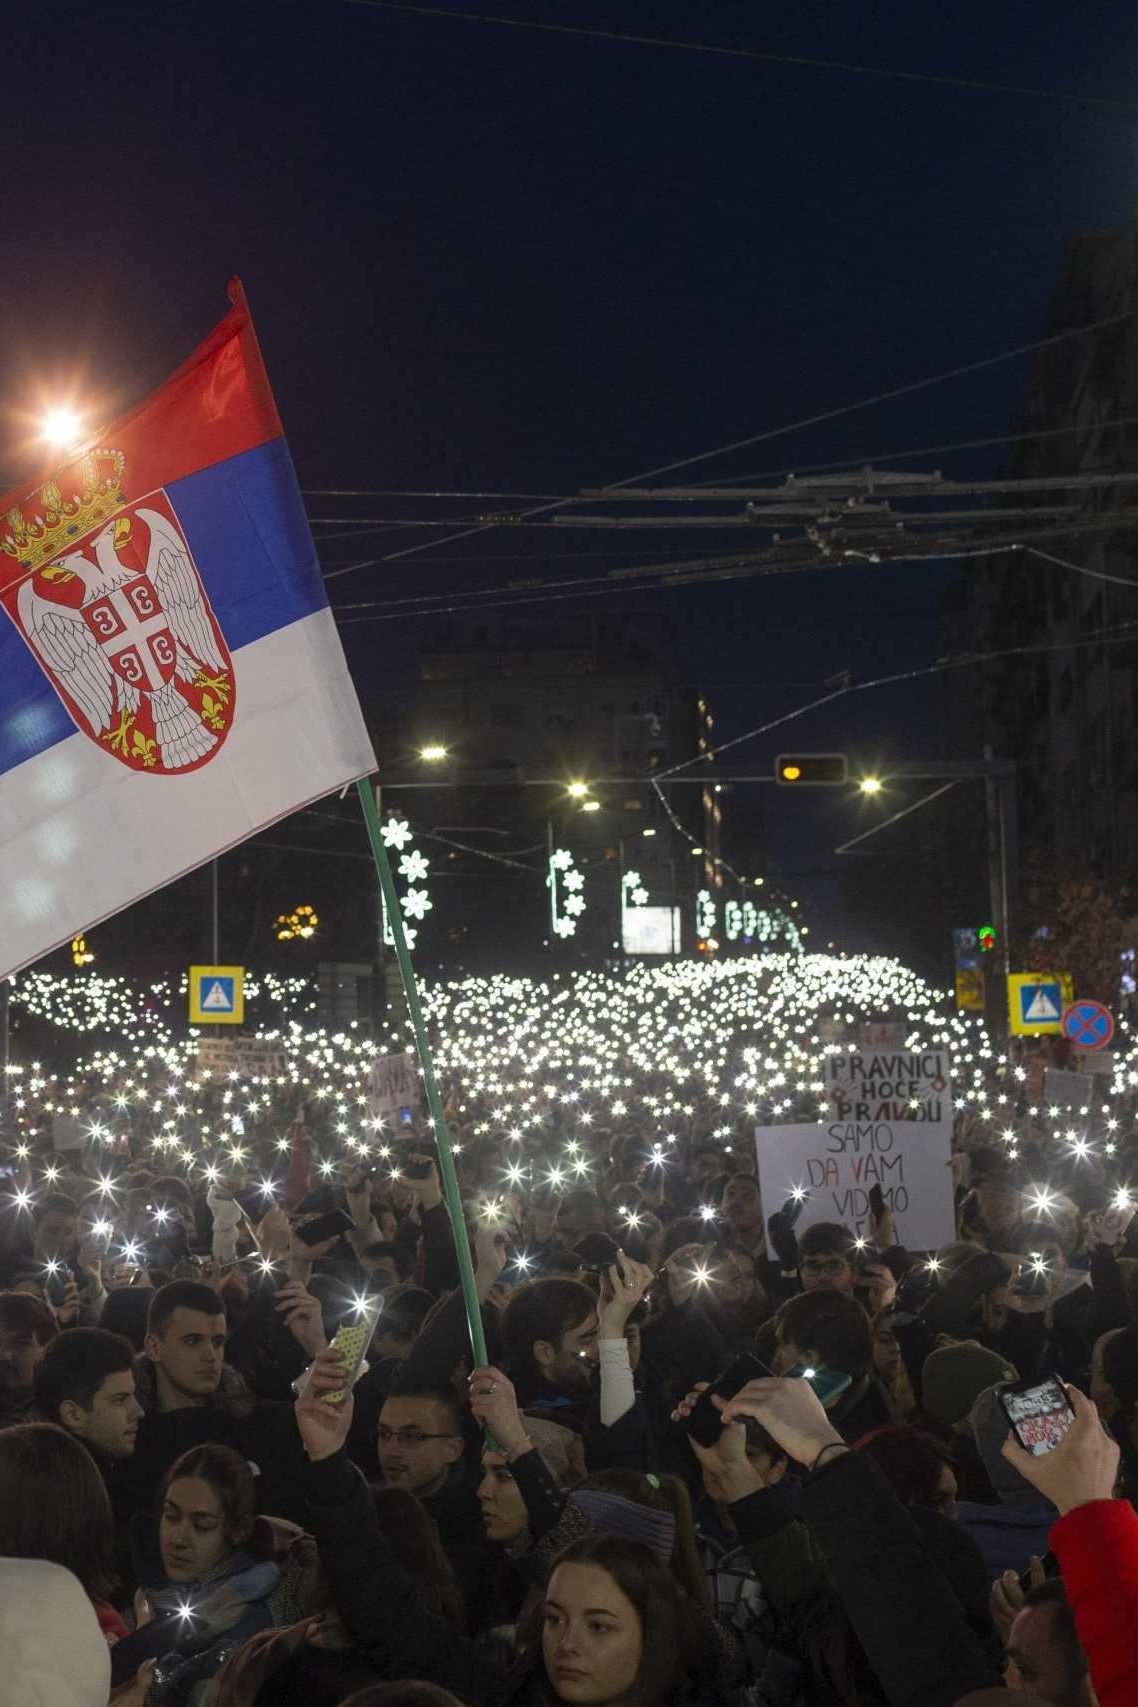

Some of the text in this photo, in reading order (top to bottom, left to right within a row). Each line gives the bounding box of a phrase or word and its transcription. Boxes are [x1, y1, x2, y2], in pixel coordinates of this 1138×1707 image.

[830, 1054, 942, 1077] PRAVNICI
[826, 1123, 894, 1153] SAMO
[806, 1152, 904, 1187] DA VAM
[831, 1186, 909, 1217] VIDMO
